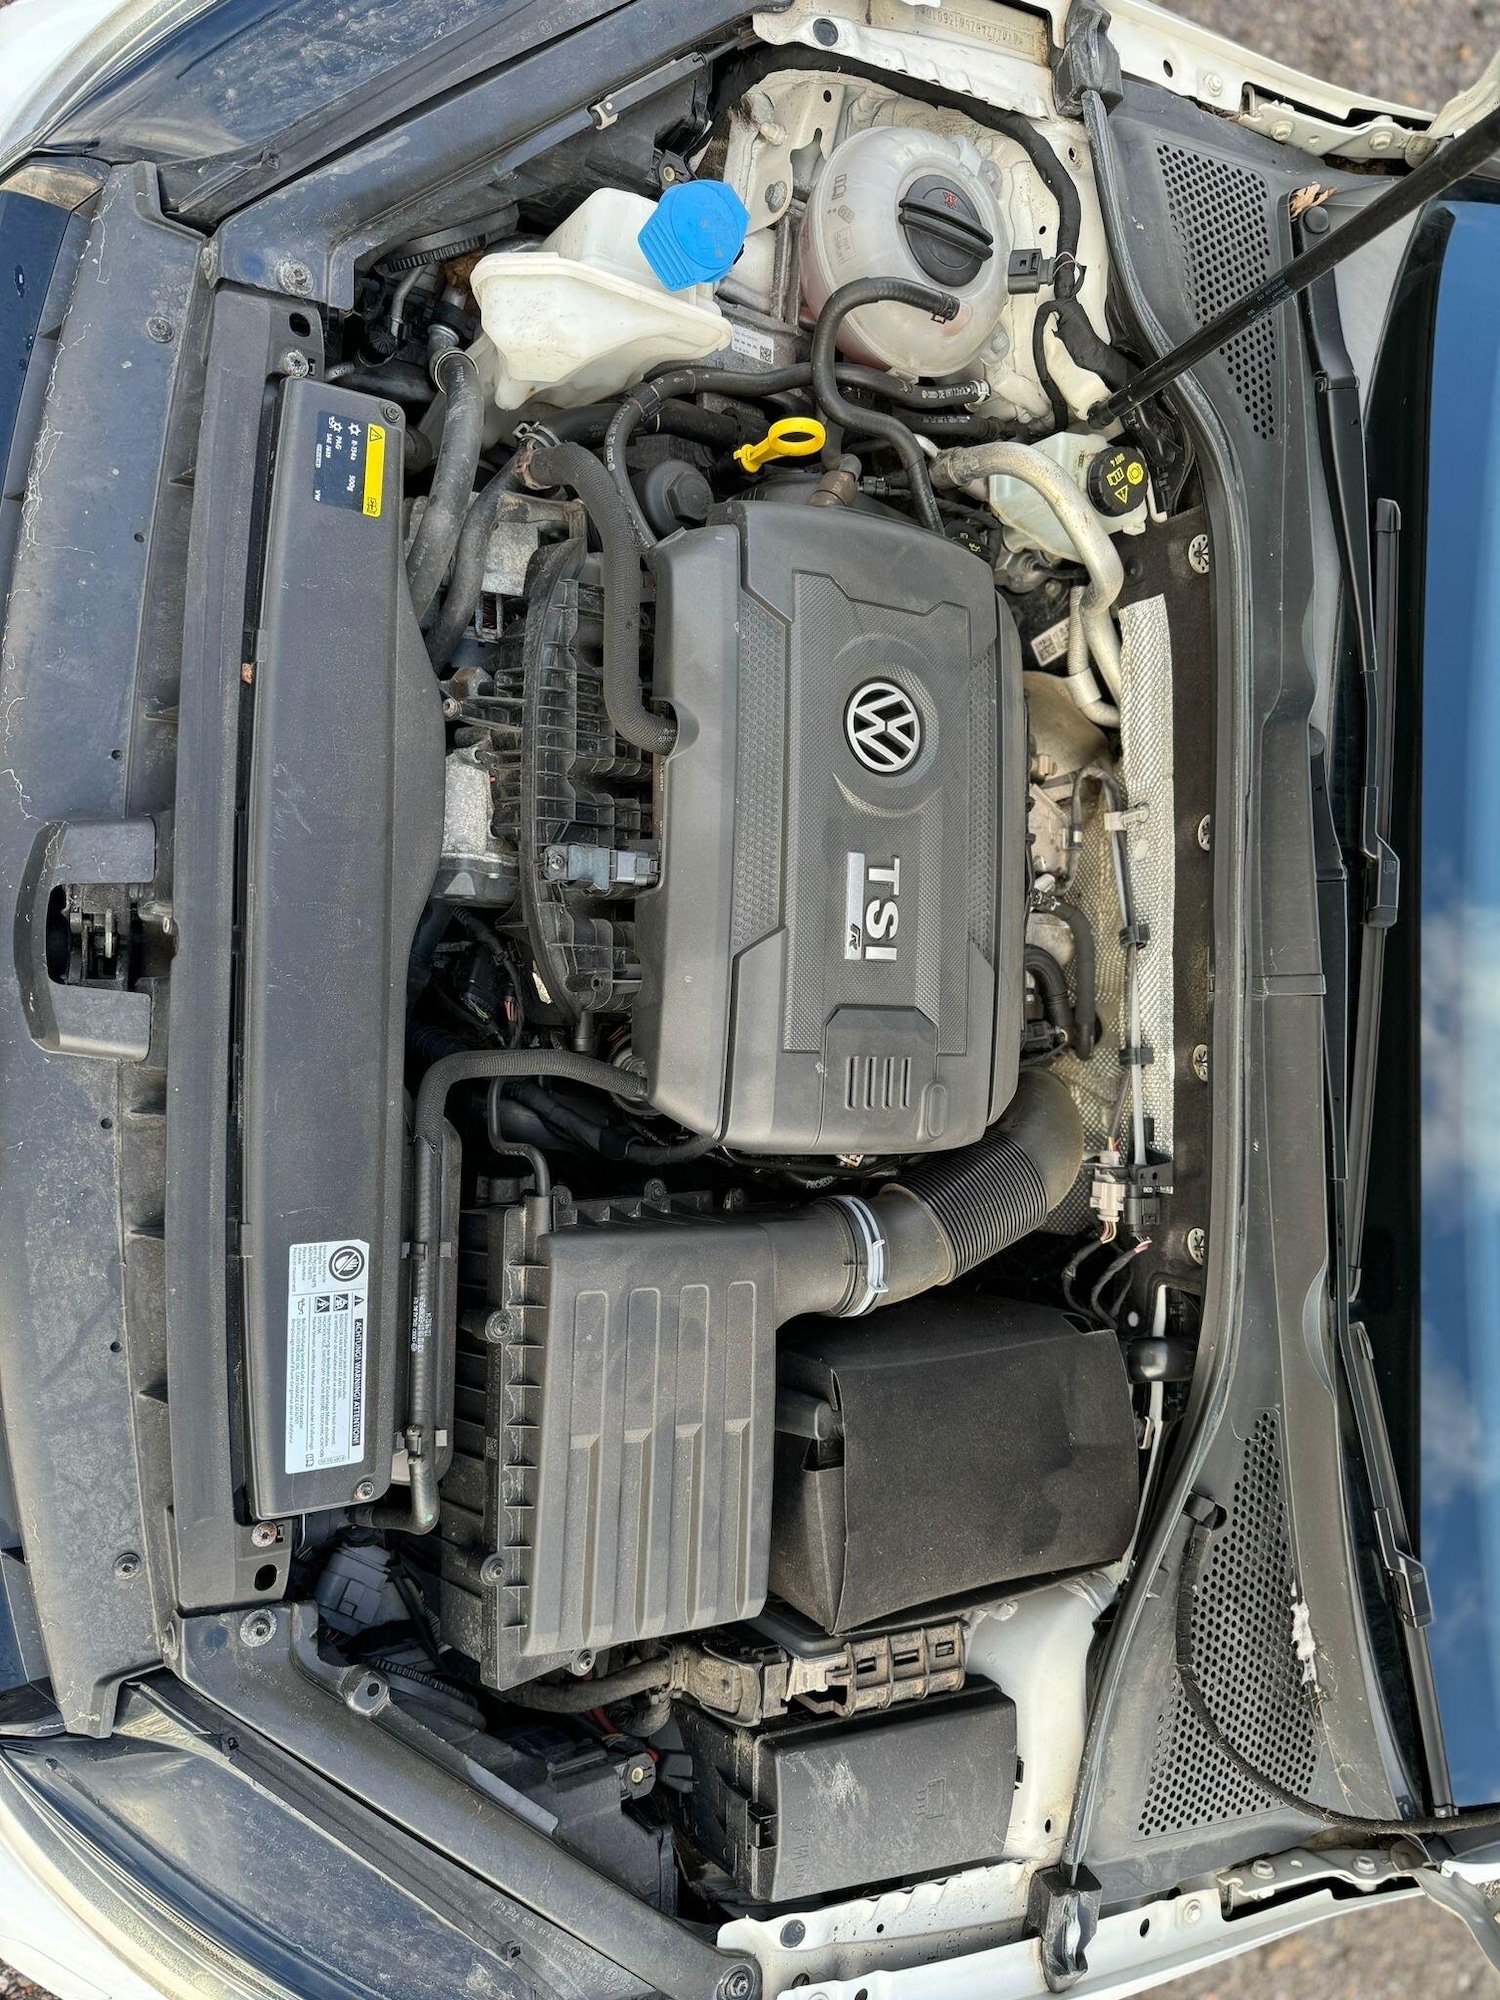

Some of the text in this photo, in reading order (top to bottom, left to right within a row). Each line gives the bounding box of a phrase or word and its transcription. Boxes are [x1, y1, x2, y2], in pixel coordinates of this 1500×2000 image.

[1114, 453, 1125, 464] DOT
[346, 475, 356, 492] 500g
[314, 489, 321, 502] VW
[865, 856, 900, 962] TSI
[352, 1321, 363, 1444] ACHTUNG! WARNING! ATTENTION!
